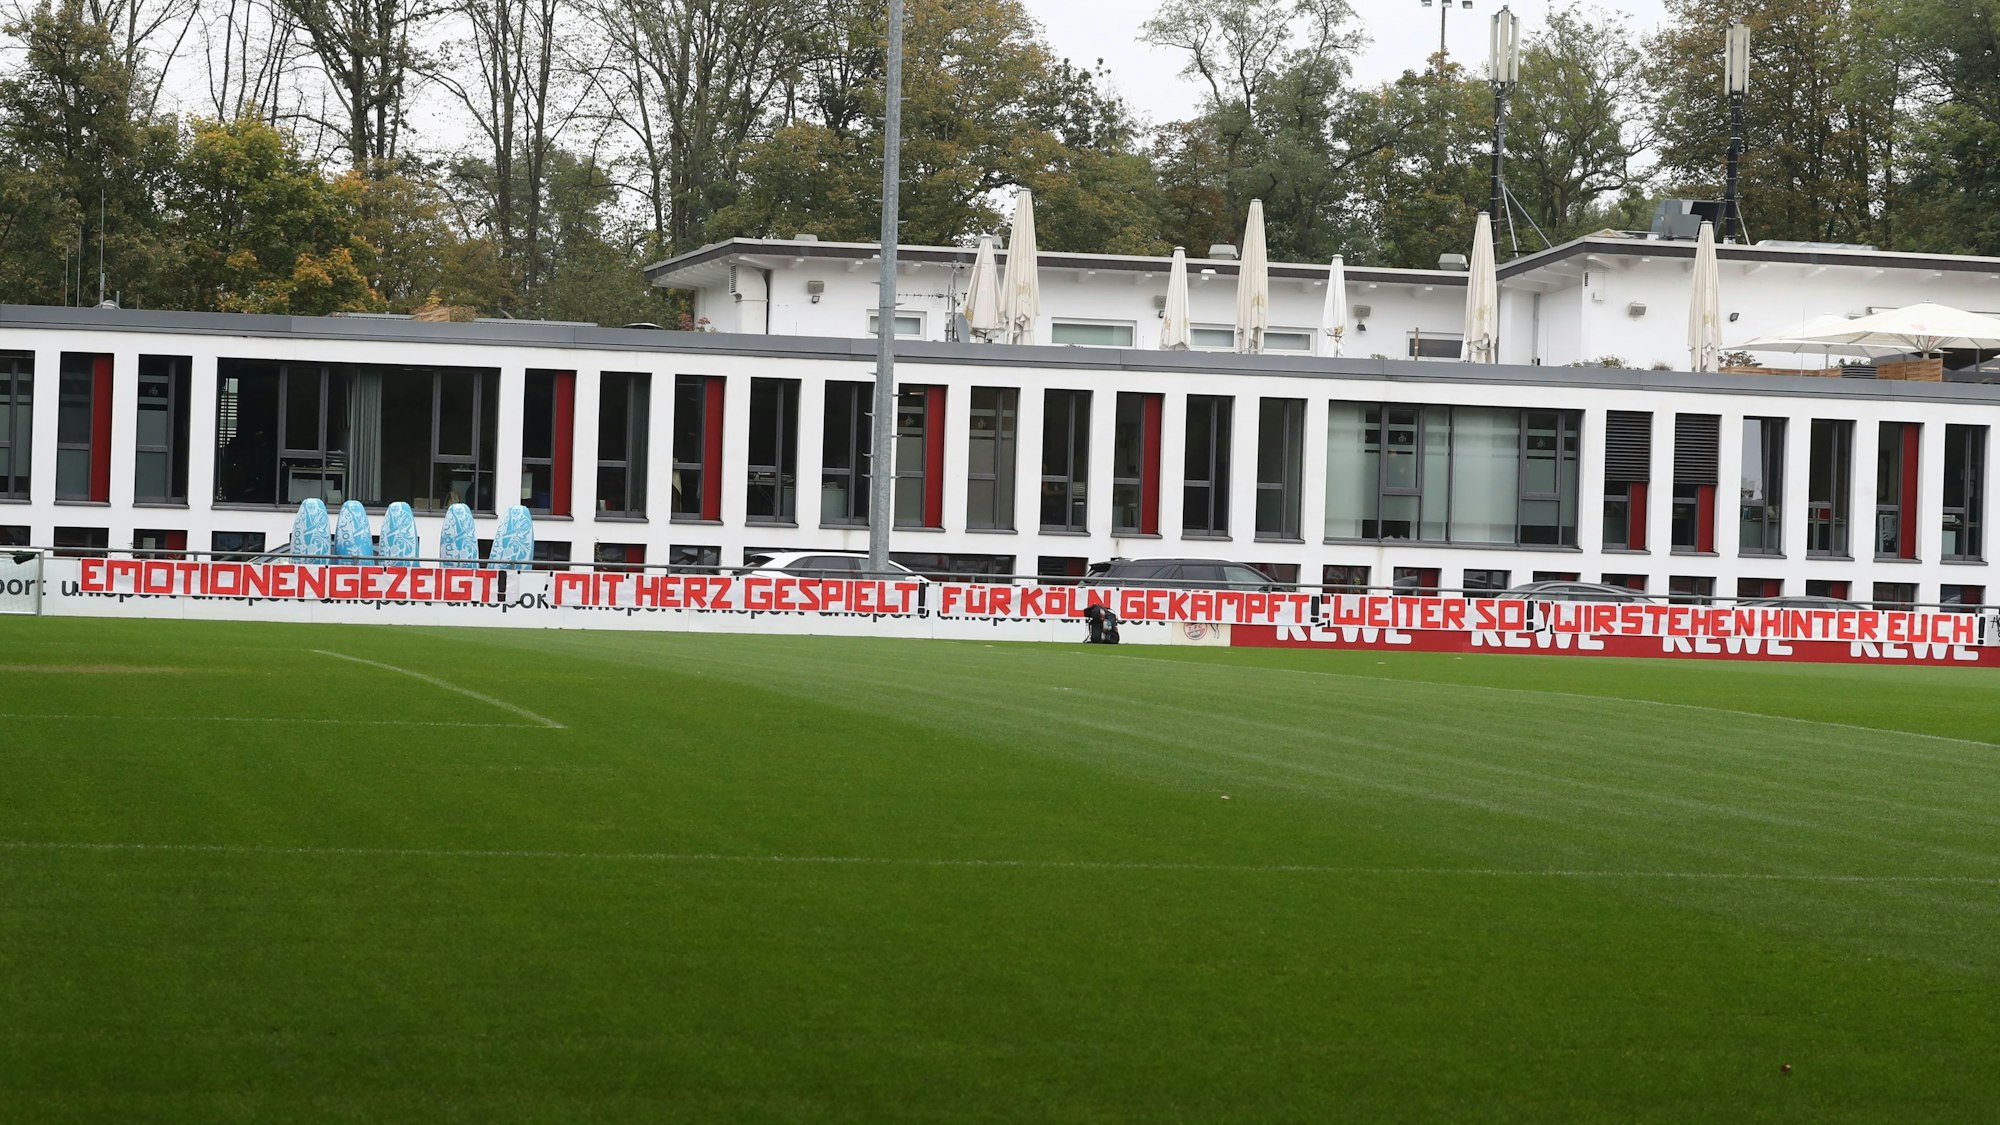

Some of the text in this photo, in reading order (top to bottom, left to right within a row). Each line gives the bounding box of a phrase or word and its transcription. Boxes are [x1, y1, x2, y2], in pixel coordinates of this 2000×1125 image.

[81, 559, 326, 598] EMOTIONEN
[328, 566, 507, 602] GEZEIGT!
[555, 573, 624, 606] MIT
[635, 575, 732, 609] HERZ
[744, 578, 926, 614] GESPIELT!
[942, 585, 1320, 623] FÜR KÖLN GEKÄMPFT!
[1333, 595, 1534, 631] WEITER SO!
[1554, 604, 1617, 634] WIR
[1621, 605, 1755, 637] STEHEN
[1760, 609, 1879, 640] HINTER
[1887, 613, 1986, 645] EUCH!
